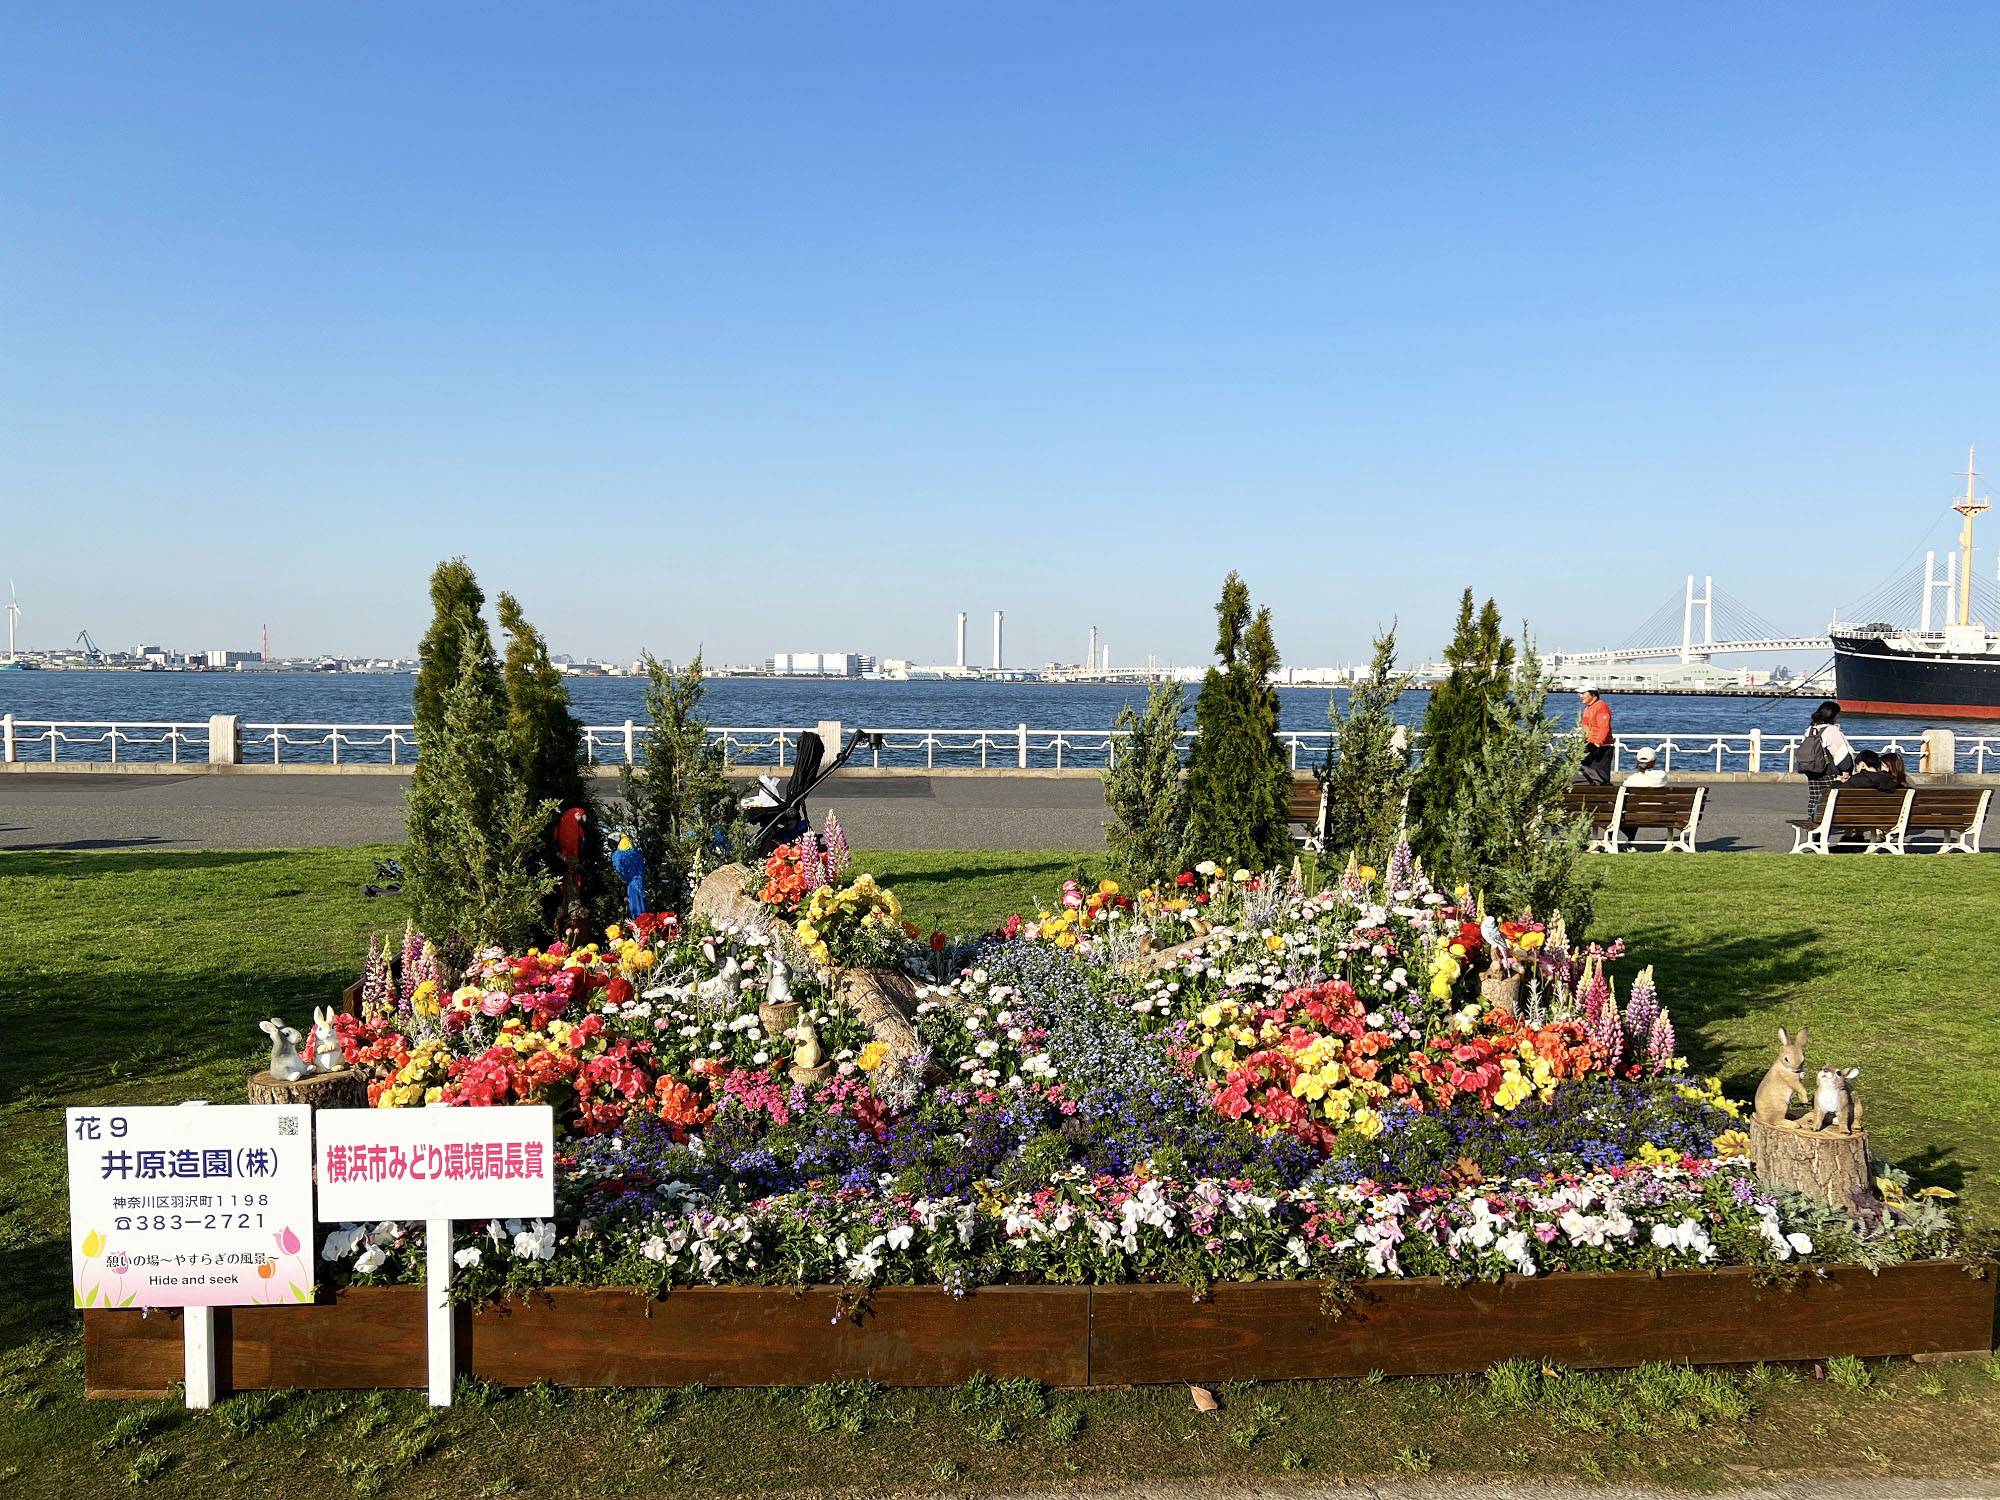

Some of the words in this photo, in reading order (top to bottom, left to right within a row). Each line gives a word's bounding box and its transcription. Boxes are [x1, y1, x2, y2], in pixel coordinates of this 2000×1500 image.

[75, 1116, 128, 1141] 花9
[100, 1147, 278, 1180] 井原造園(株)
[326, 1140, 544, 1184] 横浜市みどり環境局長賞
[112, 1194, 269, 1210] 神奈川区羽沢町1198
[149, 1275, 178, 1286] Hide
[181, 1274, 206, 1286] and
[209, 1274, 239, 1285] seek
